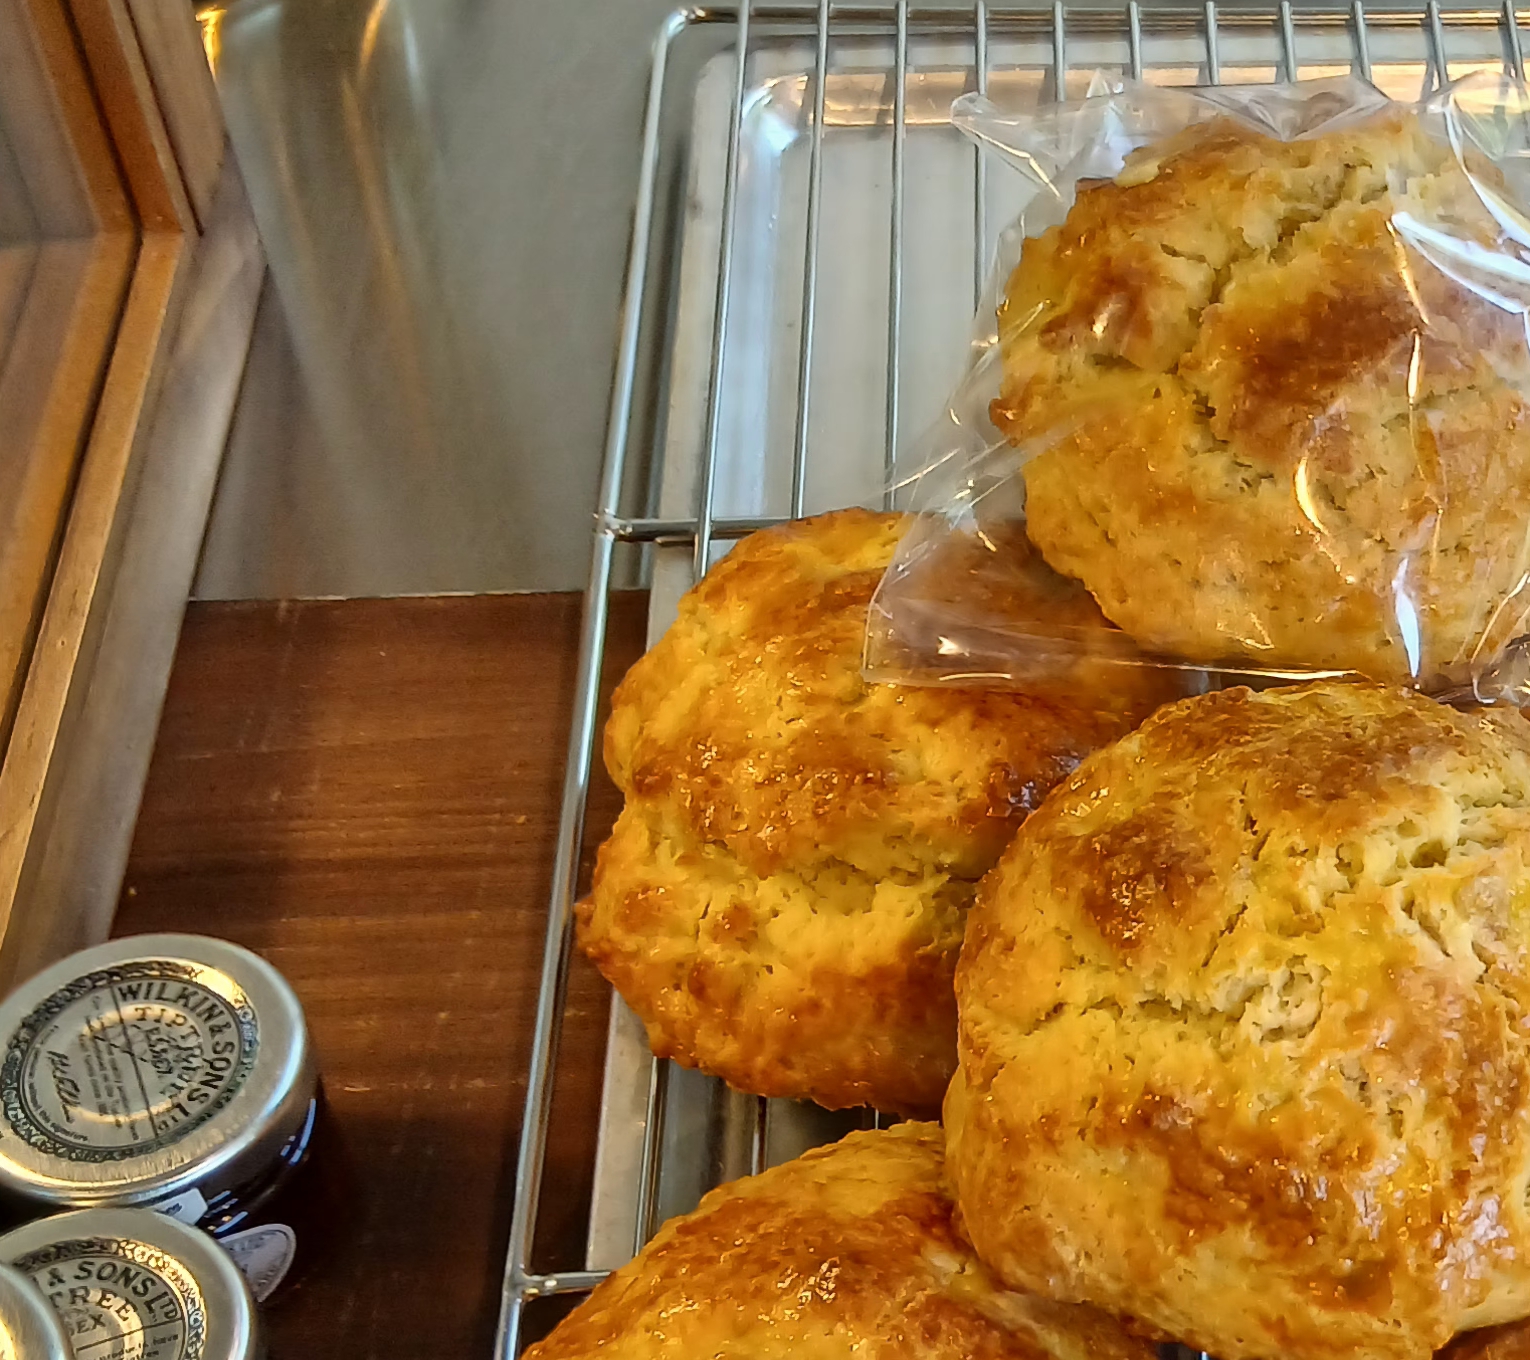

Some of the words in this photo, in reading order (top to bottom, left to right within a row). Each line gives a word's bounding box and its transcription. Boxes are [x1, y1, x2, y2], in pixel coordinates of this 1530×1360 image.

[118, 982, 225, 1023] WILKIN
[209, 1021, 232, 1040] &
[187, 1040, 236, 1106] SONS
[73, 1260, 157, 1298] SONS
[48, 1285, 138, 1322] TREE
